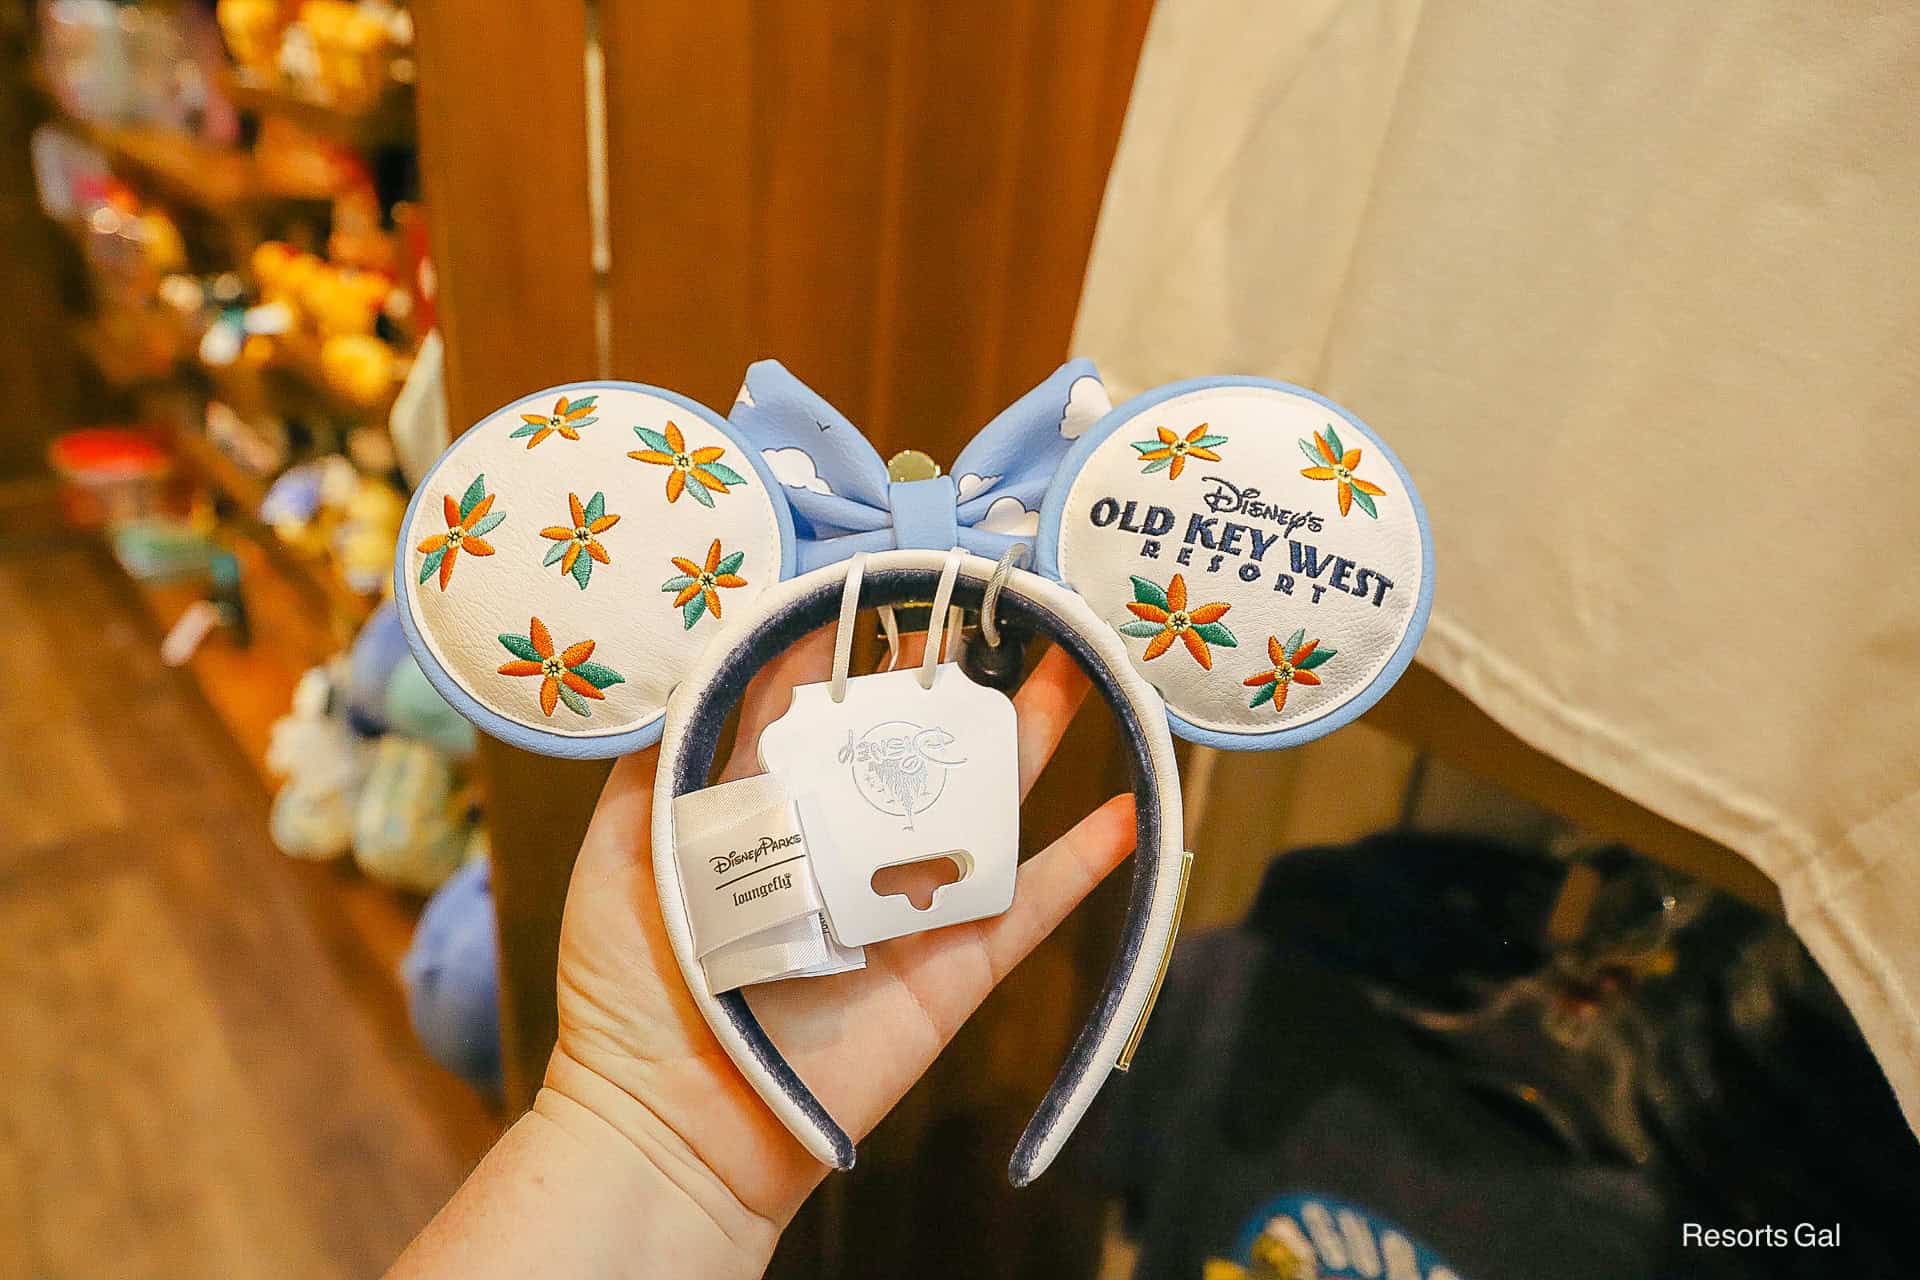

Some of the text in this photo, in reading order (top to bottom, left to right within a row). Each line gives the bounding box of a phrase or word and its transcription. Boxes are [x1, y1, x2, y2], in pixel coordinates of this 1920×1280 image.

[1089, 496, 1395, 608] OLD KEY WEST
[1140, 538, 1328, 605] RESORT
[732, 872, 793, 907] loungefly
